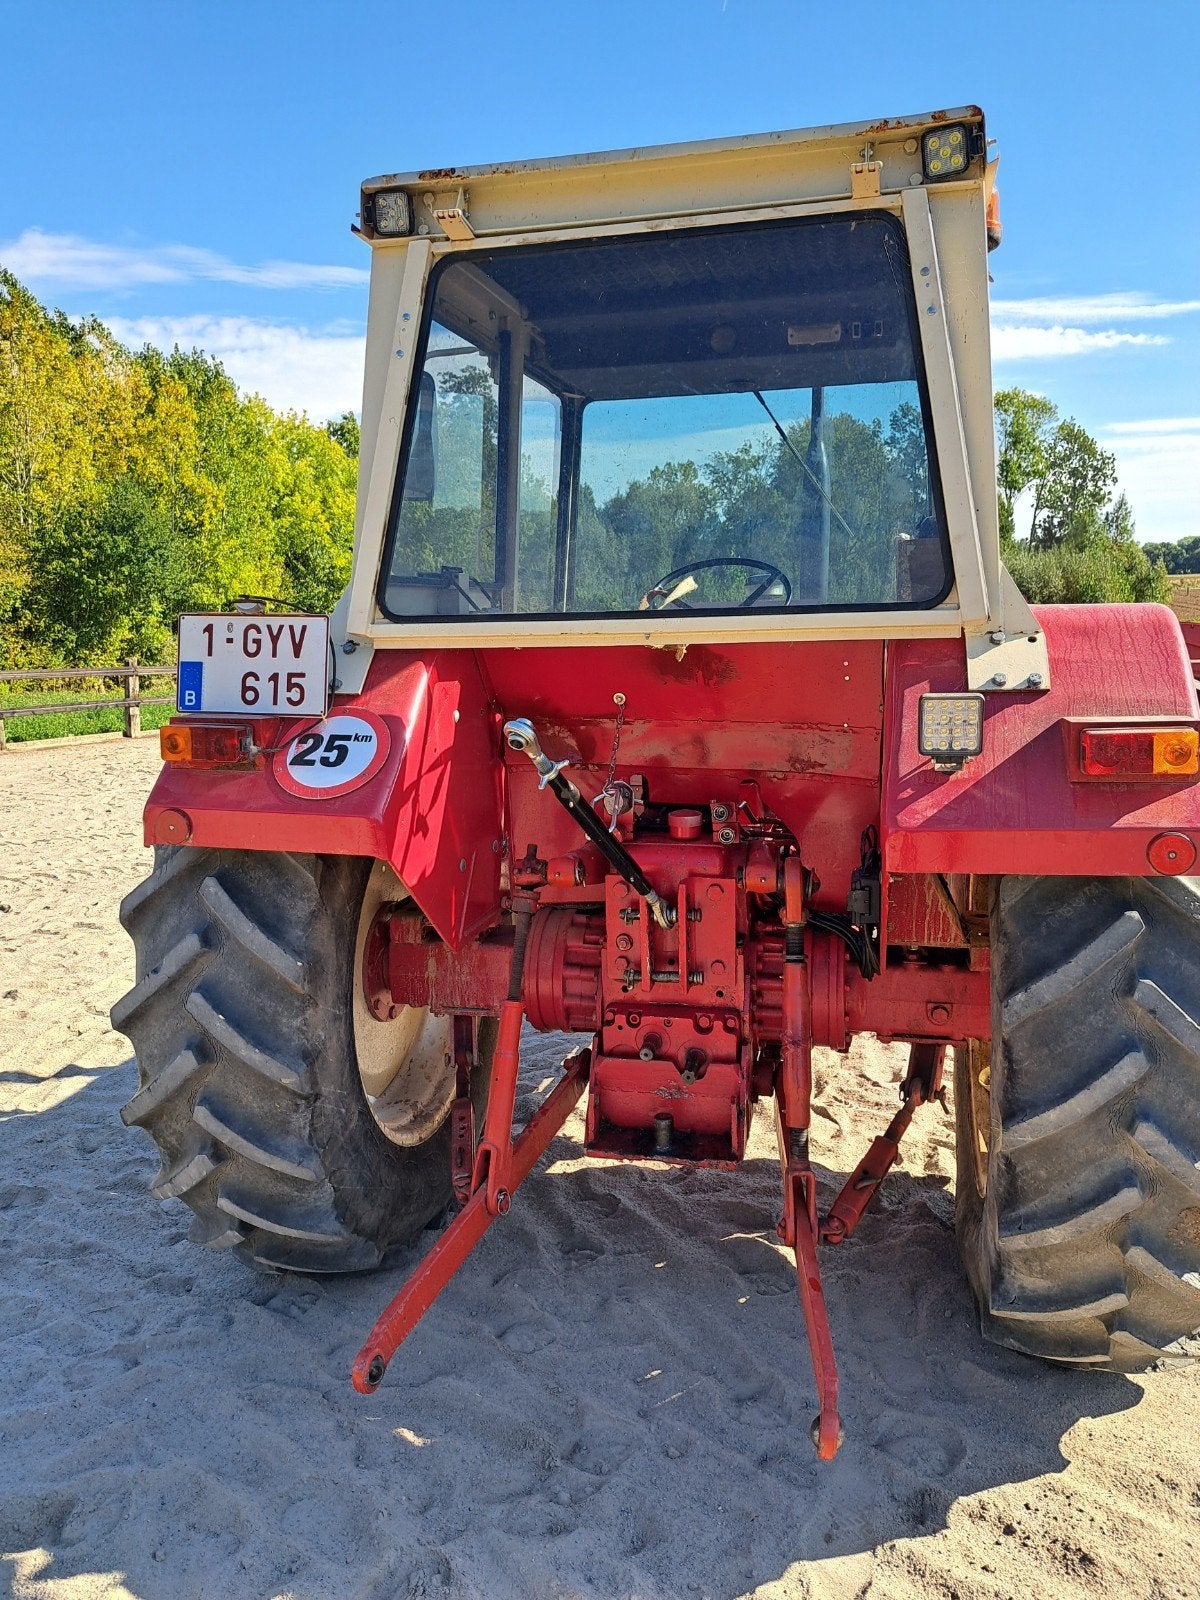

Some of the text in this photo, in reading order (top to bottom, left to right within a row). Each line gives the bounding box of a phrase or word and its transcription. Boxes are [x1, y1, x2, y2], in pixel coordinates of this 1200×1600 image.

[184, 690, 196, 706] B
[240, 671, 306, 707] 615
[288, 732, 373, 768] 25 km
